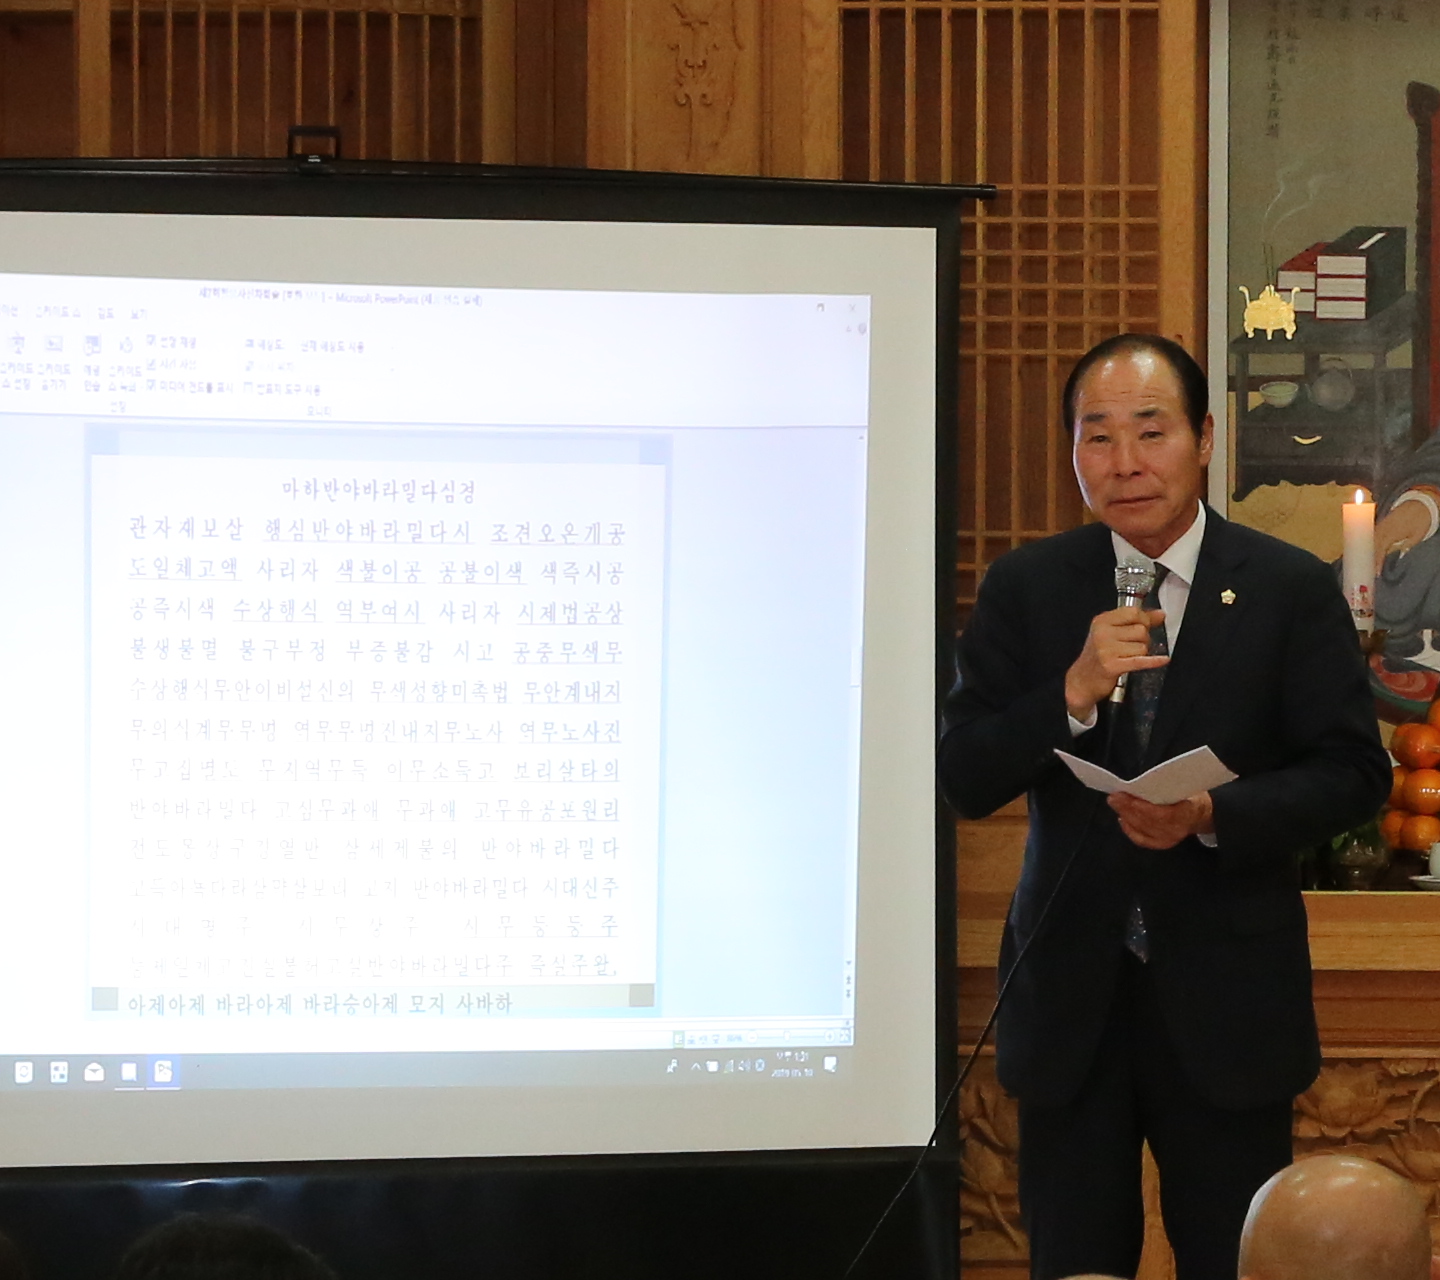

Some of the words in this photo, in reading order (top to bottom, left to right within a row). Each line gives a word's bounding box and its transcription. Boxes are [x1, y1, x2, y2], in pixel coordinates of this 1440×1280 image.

[282, 477, 477, 504] 마하반야바라밀다심경
[129, 515, 245, 542] 관자재보살
[264, 519, 472, 544] 행심반야바라밀다시
[491, 521, 626, 546] 조견오온개공
[129, 557, 240, 581] 도일체고액
[256, 558, 319, 582] 사리자
[336, 560, 423, 584] 색불이공
[438, 561, 524, 585] 공불이색
[540, 561, 626, 586] 색즉시공
[129, 597, 215, 622] 공즉시색
[233, 598, 318, 622] 수상행식
[336, 600, 423, 624] 역부여시
[438, 600, 501, 624] 사리자
[517, 601, 623, 624] 시제법공상
[129, 637, 218, 660] 불생불멸
[240, 639, 327, 662] 불구부정
[346, 639, 433, 664] 부증불감
[454, 640, 494, 664] 시고
[128, 994, 205, 1016] 아제아제
[216, 995, 292, 1016] 바라아제
[303, 993, 400, 1015] 바라승아제
[409, 994, 445, 1014] 모지
[455, 993, 513, 1014] 사바하
